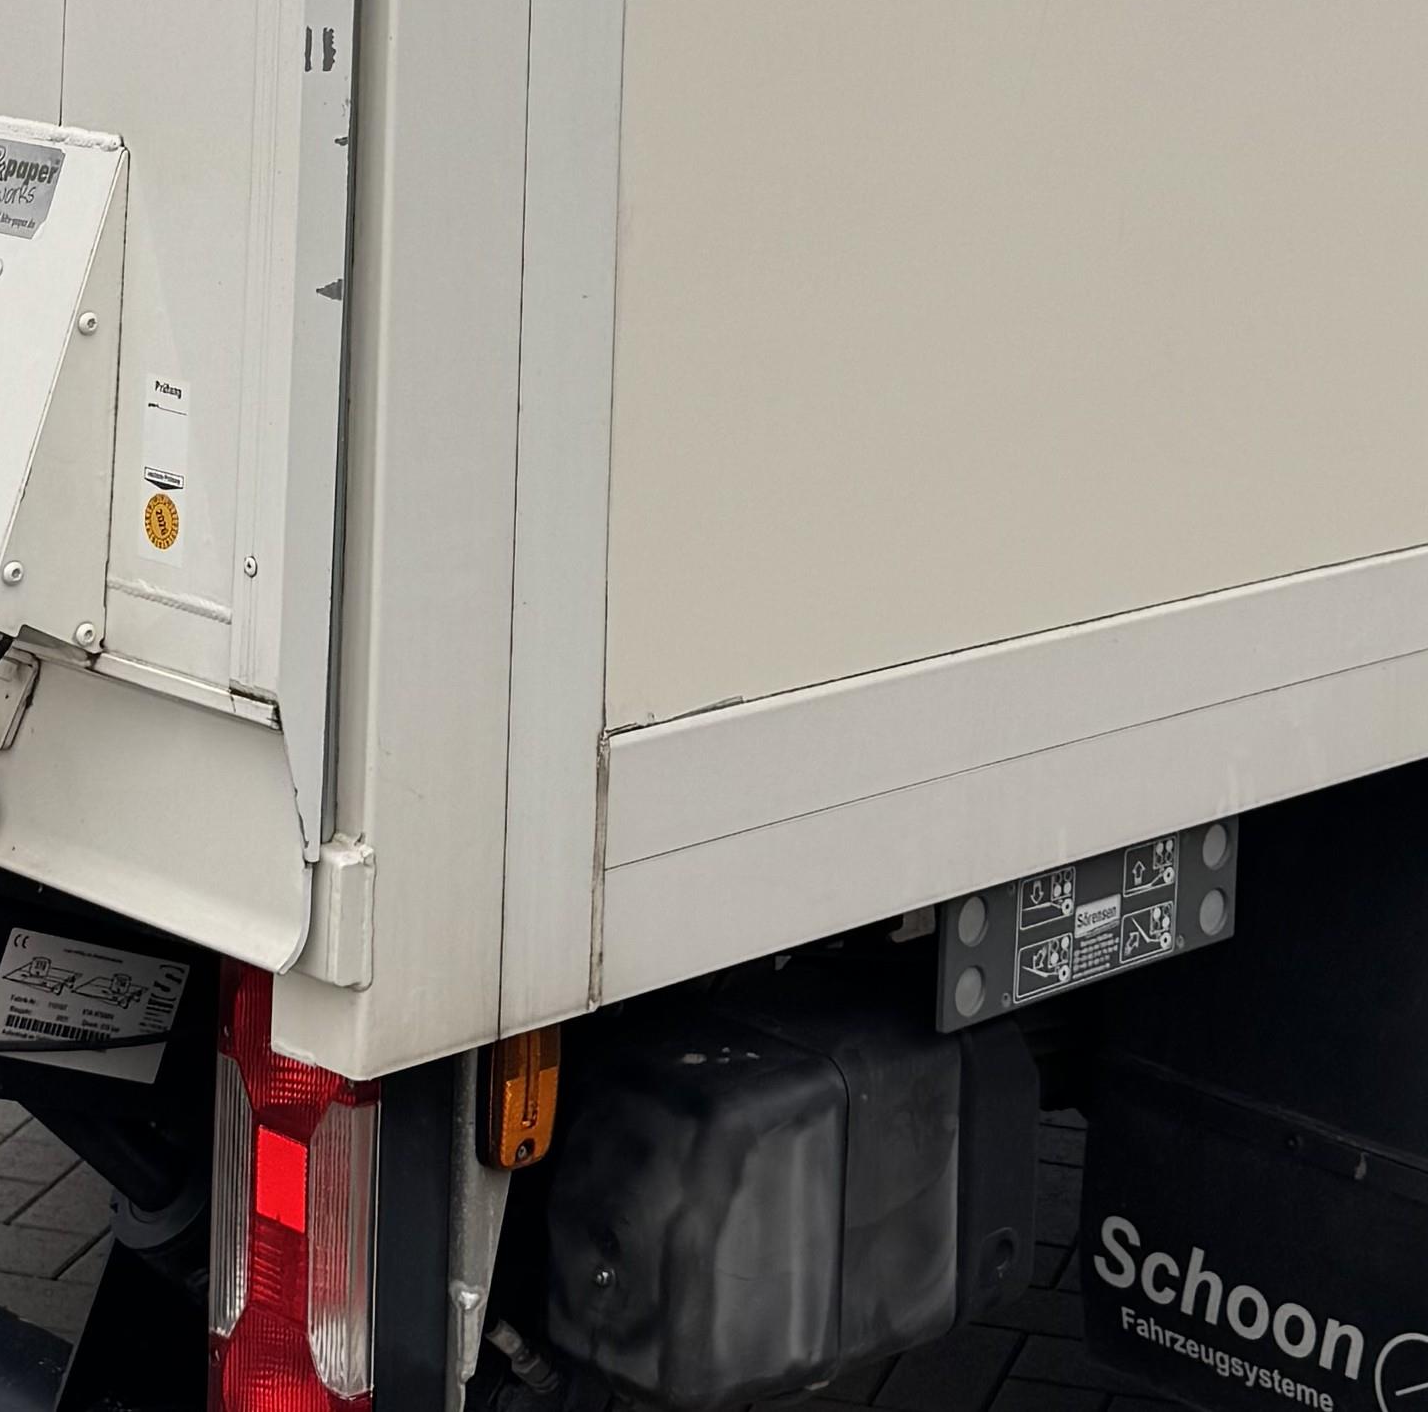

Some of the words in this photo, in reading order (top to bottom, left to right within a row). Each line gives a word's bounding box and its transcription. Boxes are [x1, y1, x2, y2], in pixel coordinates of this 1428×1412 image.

[1076, 905, 1117, 929] Sörensen
[1093, 1215, 1365, 1381] Schoon
[1121, 1306, 1335, 1412] Fahrzeugsysteme
